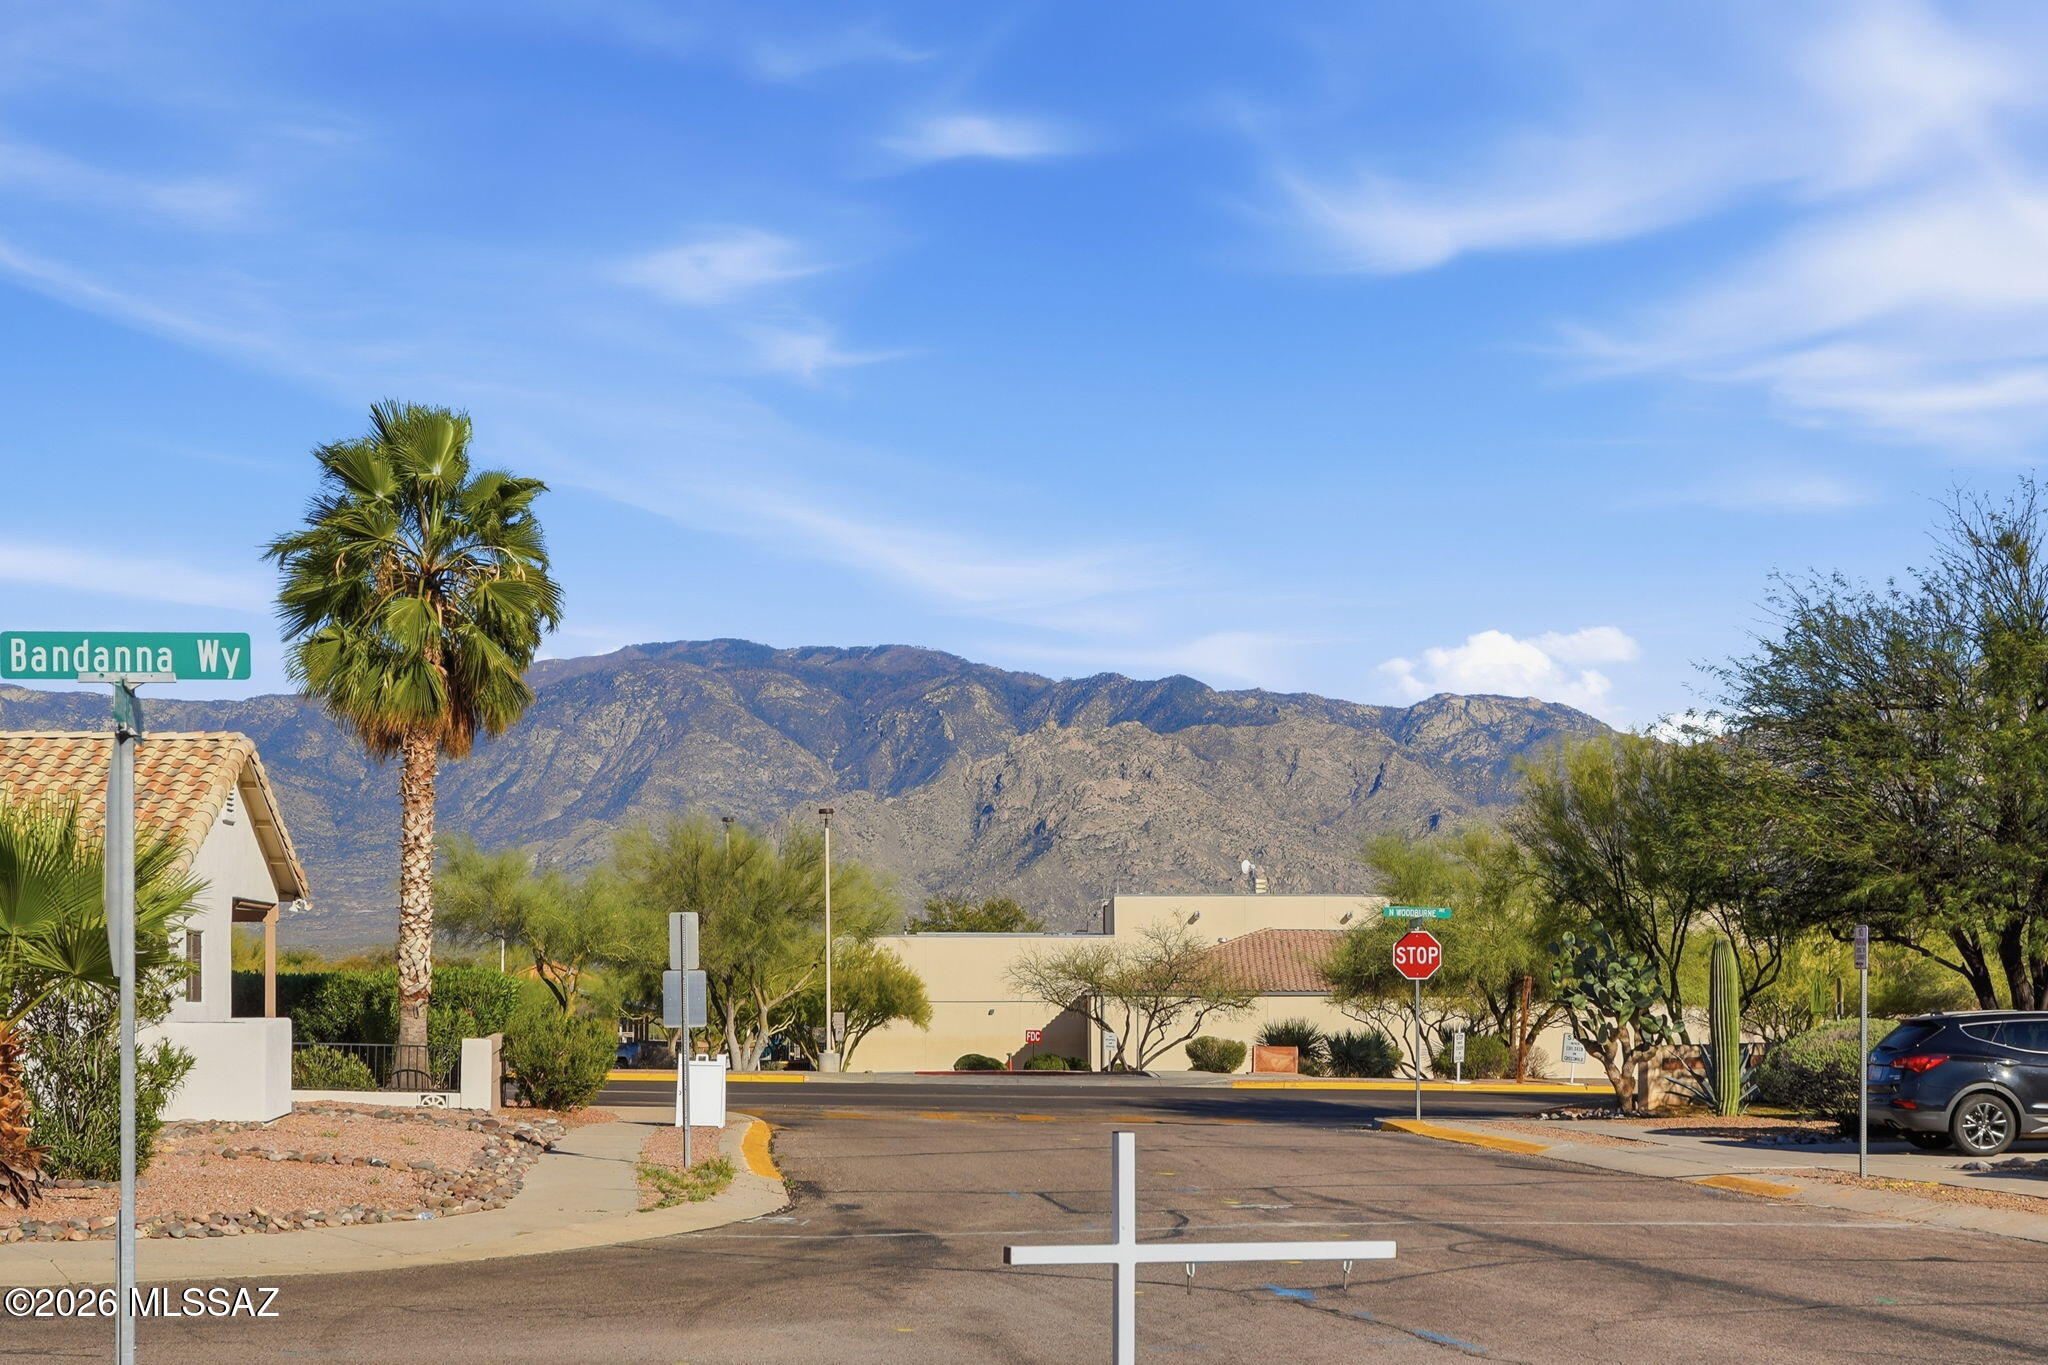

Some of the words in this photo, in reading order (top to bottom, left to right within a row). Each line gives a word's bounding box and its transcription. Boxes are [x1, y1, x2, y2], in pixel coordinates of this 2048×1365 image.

[11, 638, 173, 673] Bandanna
[197, 639, 240, 679] Wy
[1395, 909, 1437, 918] WOODBURNE
[1396, 946, 1439, 965] STOP
[1026, 1031, 1041, 1042] FDC
